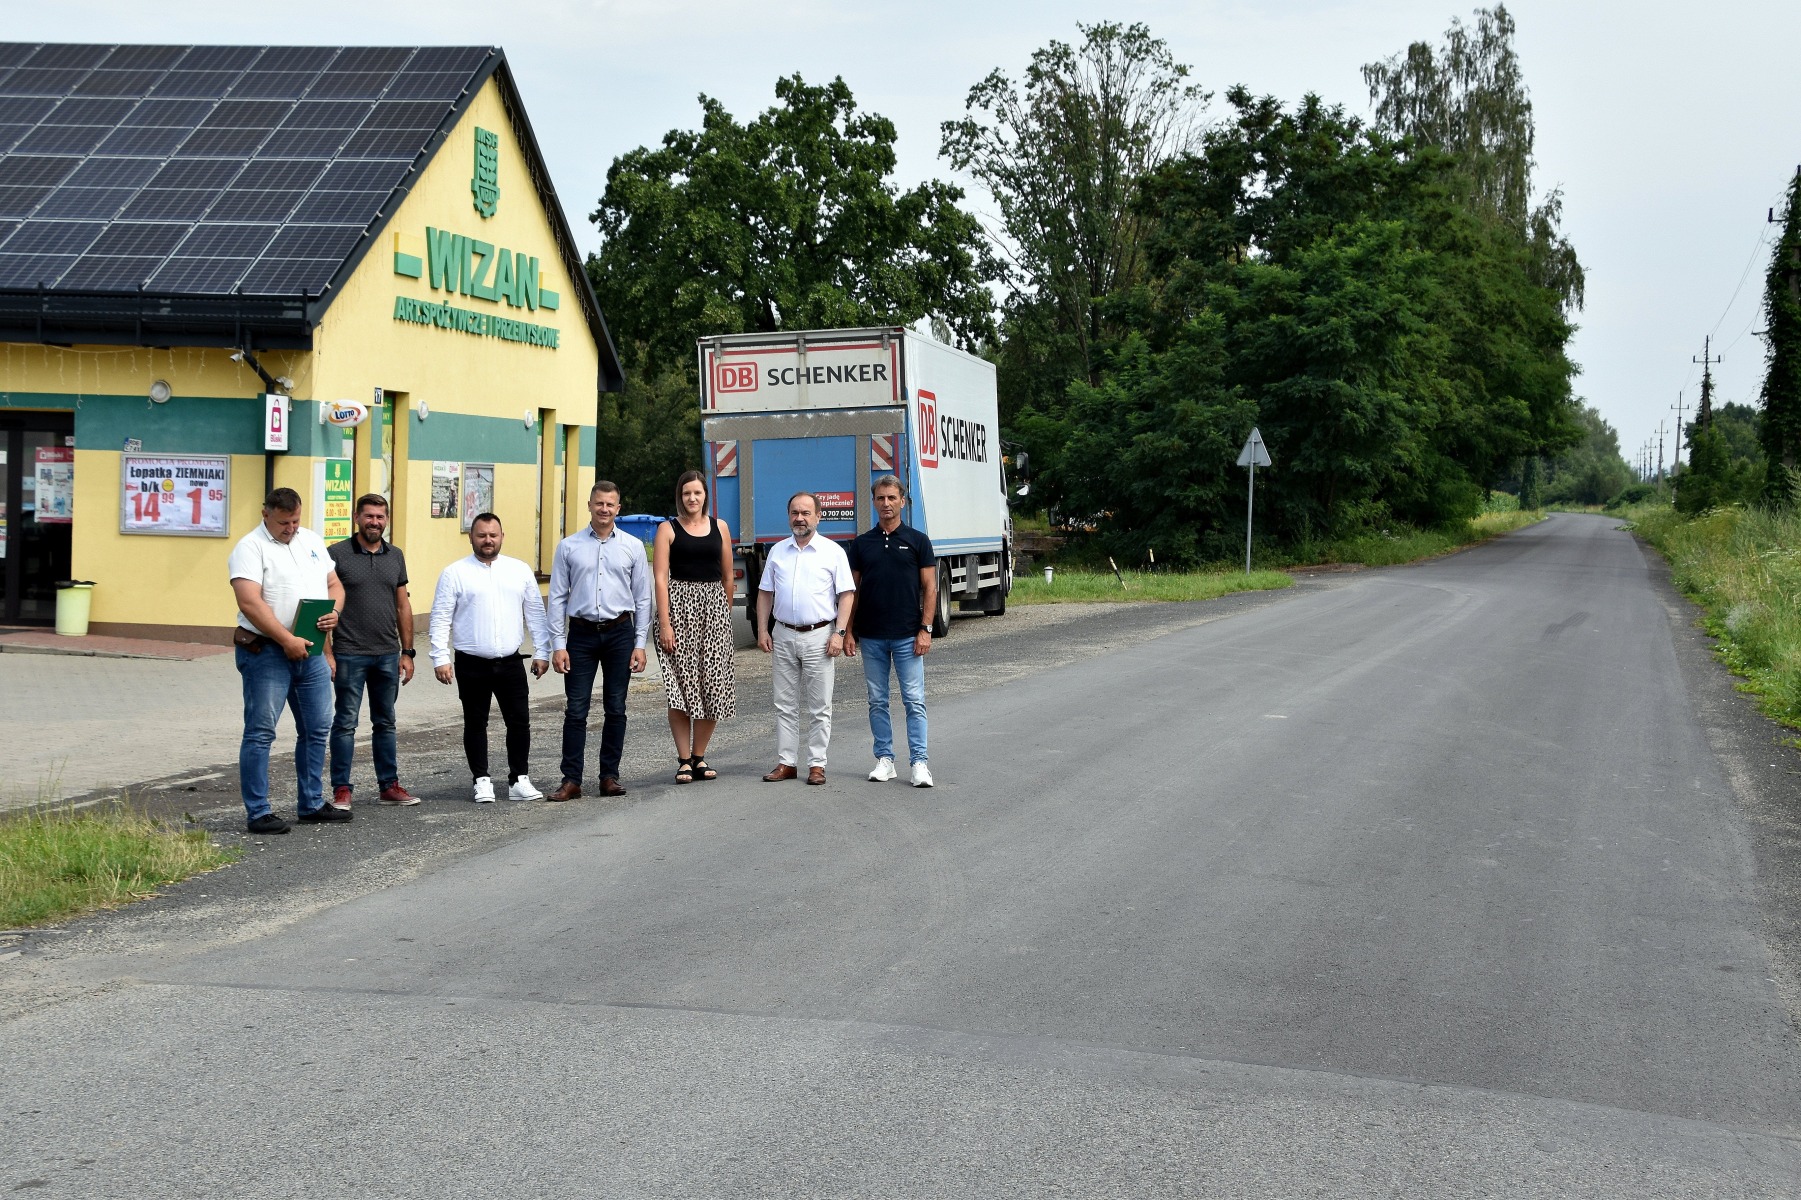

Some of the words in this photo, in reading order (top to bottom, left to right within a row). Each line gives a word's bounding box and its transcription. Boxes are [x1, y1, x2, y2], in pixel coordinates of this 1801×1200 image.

[475, 126, 499, 149] MSH
[426, 226, 539, 311] WIZAN
[493, 315, 560, 349] PRZEMYSŁOWE
[721, 366, 754, 389] DB
[767, 363, 888, 387] SCHENKER
[335, 409, 355, 420] LOTTO
[919, 401, 936, 457] DB
[941, 414, 988, 463] SCHENKER
[130, 466, 172, 479] Łopatka
[175, 467, 225, 480] ZIEMNIAKI
[141, 481, 160, 493] b/k
[325, 480, 350, 492] WIZAN
[131, 492, 160, 522] 14
[162, 492, 175, 504] 99
[187, 488, 202, 524] 1
[208, 489, 223, 501] 95
